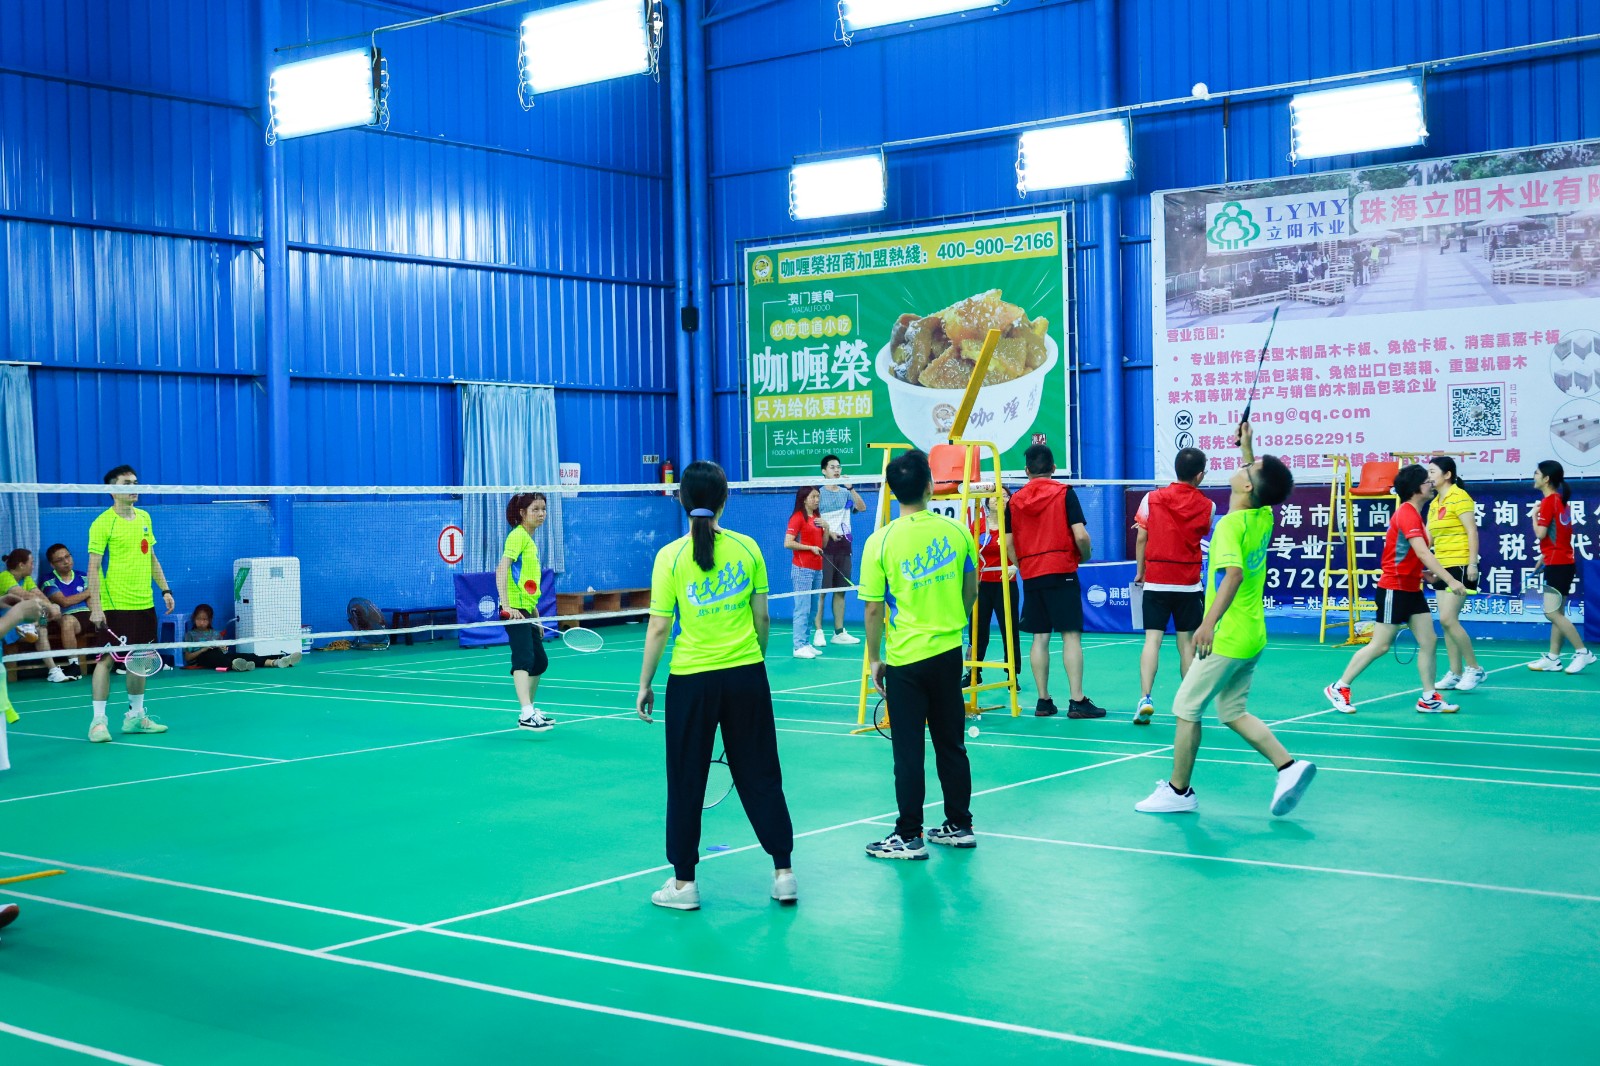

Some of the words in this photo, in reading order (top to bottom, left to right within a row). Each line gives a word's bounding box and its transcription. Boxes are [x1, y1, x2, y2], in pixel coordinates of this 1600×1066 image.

[1265, 198, 1348, 223] LYMY
[1266, 219, 1345, 241] 立阳木业
[937, 231, 1054, 260] 400-900-2166
[787, 289, 834, 306] 澳门美食
[813, 304, 831, 312] FOOD
[772, 318, 850, 338] 必吃地道小吃
[752, 339, 872, 395] 咖喱榮
[756, 394, 871, 420] 只为给你更好的
[772, 427, 852, 446] 舌尖上的美味
[1109, 587, 1130, 599] 润都
